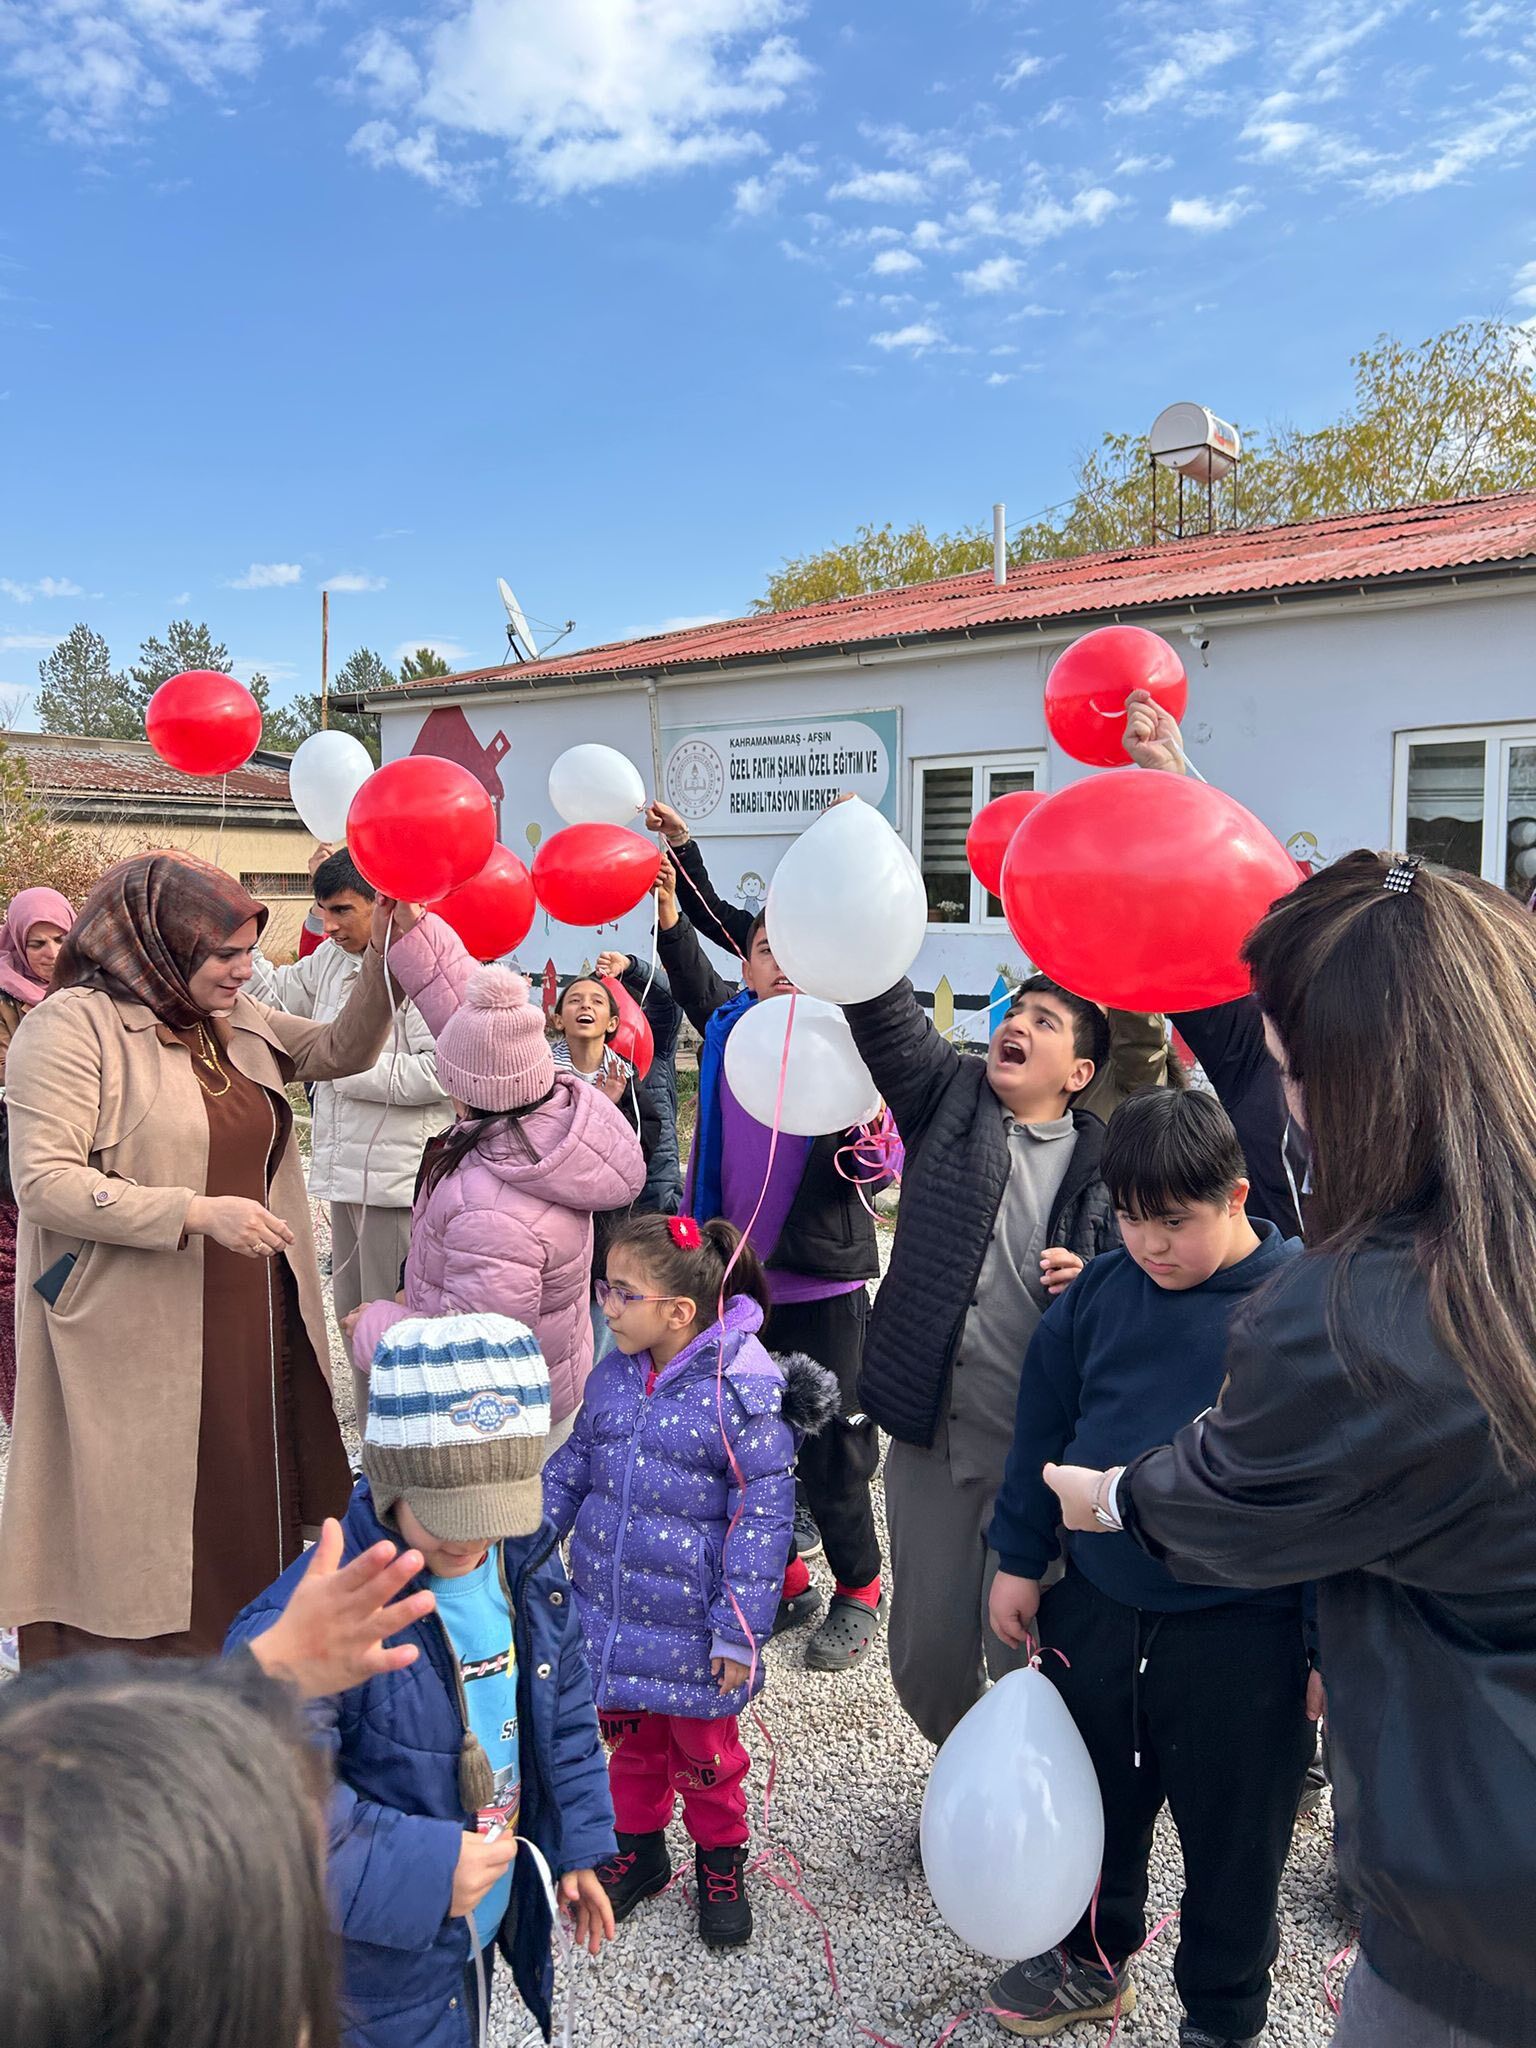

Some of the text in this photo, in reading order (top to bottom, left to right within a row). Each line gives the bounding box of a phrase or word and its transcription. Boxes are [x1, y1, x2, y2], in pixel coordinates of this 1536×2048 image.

[730, 733, 801, 748] KAHRAMANMARAŞ
[730, 753, 750, 780] ÖZEL
[778, 755, 806, 784] ŞAHAN
[809, 748, 831, 776] ÖZEL
[866, 750, 877, 773] VE
